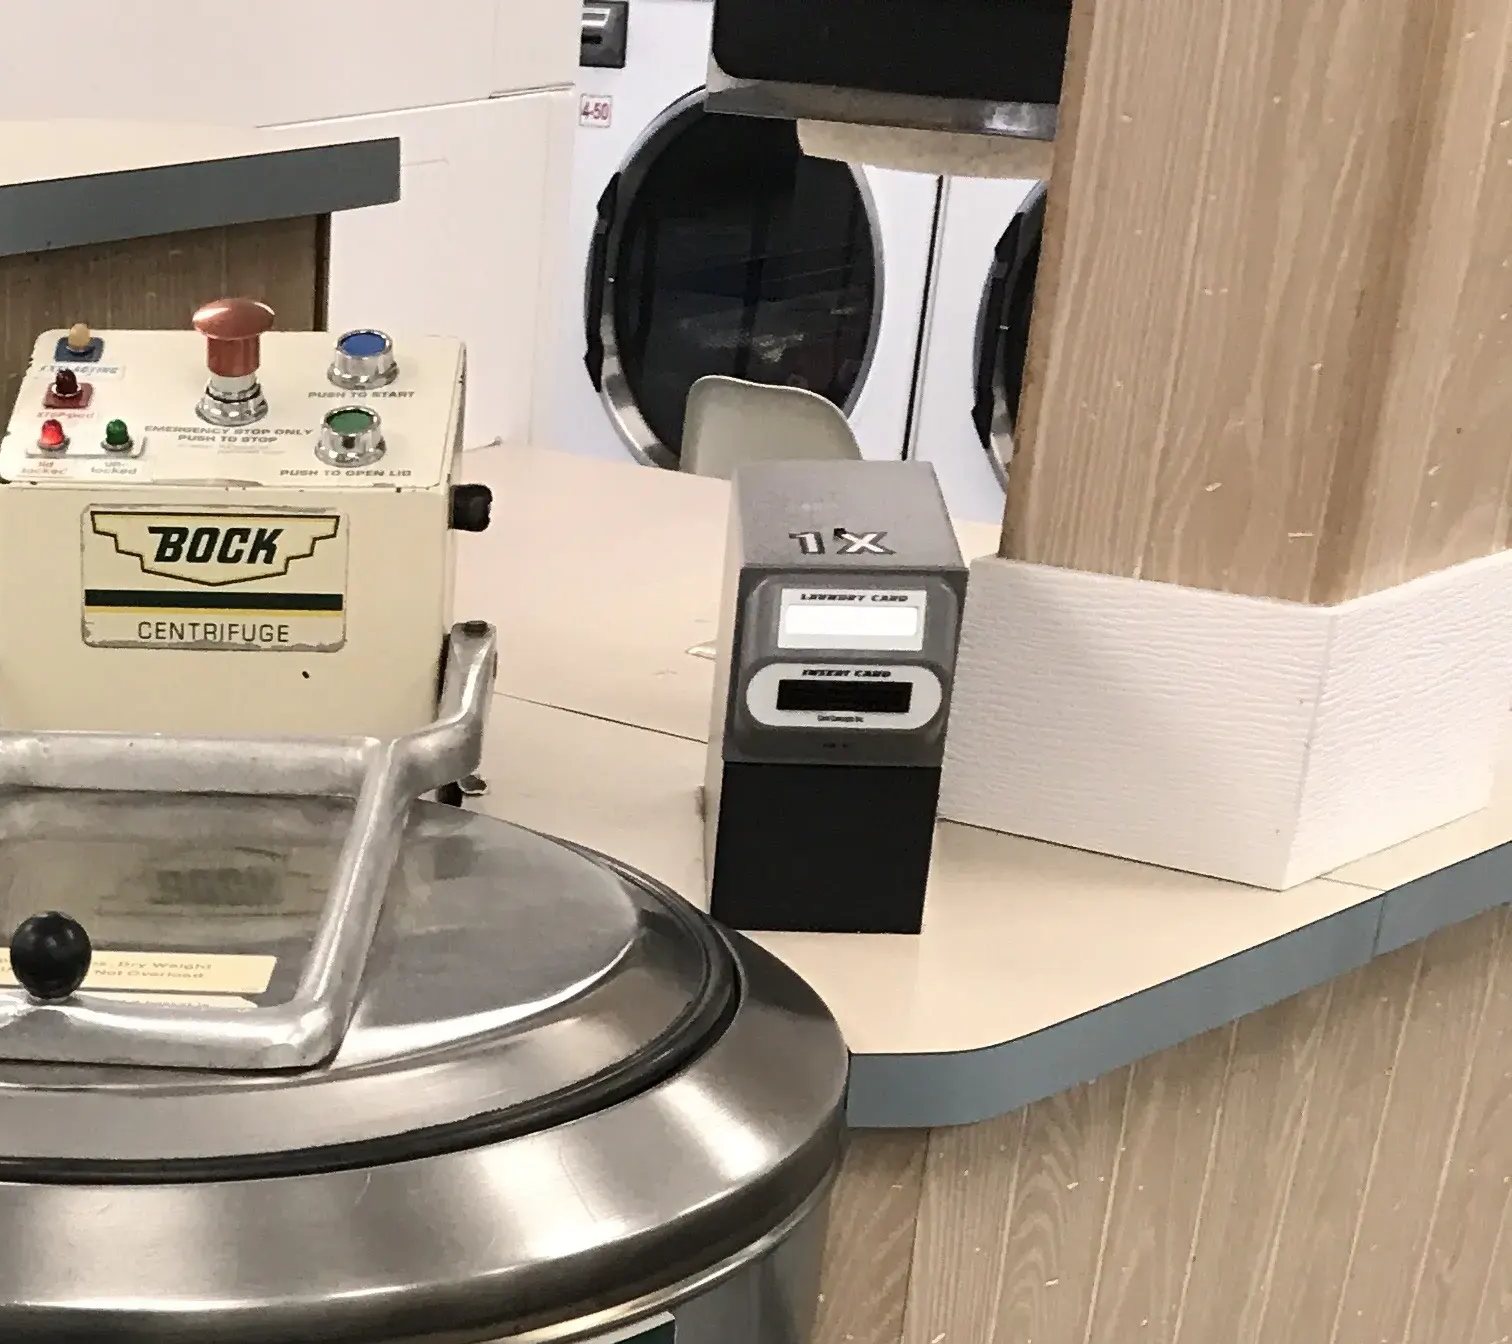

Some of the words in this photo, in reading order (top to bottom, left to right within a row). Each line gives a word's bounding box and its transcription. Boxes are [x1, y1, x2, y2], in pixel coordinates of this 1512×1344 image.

[144, 425, 230, 434] EMERGENCY
[148, 526, 284, 564] BOCK
[800, 593, 866, 602] LAUNDRY
[870, 594, 909, 602] CARD
[138, 621, 289, 642] CENTRIFUGE
[802, 669, 850, 677] INSERT
[854, 670, 892, 678] CARD
